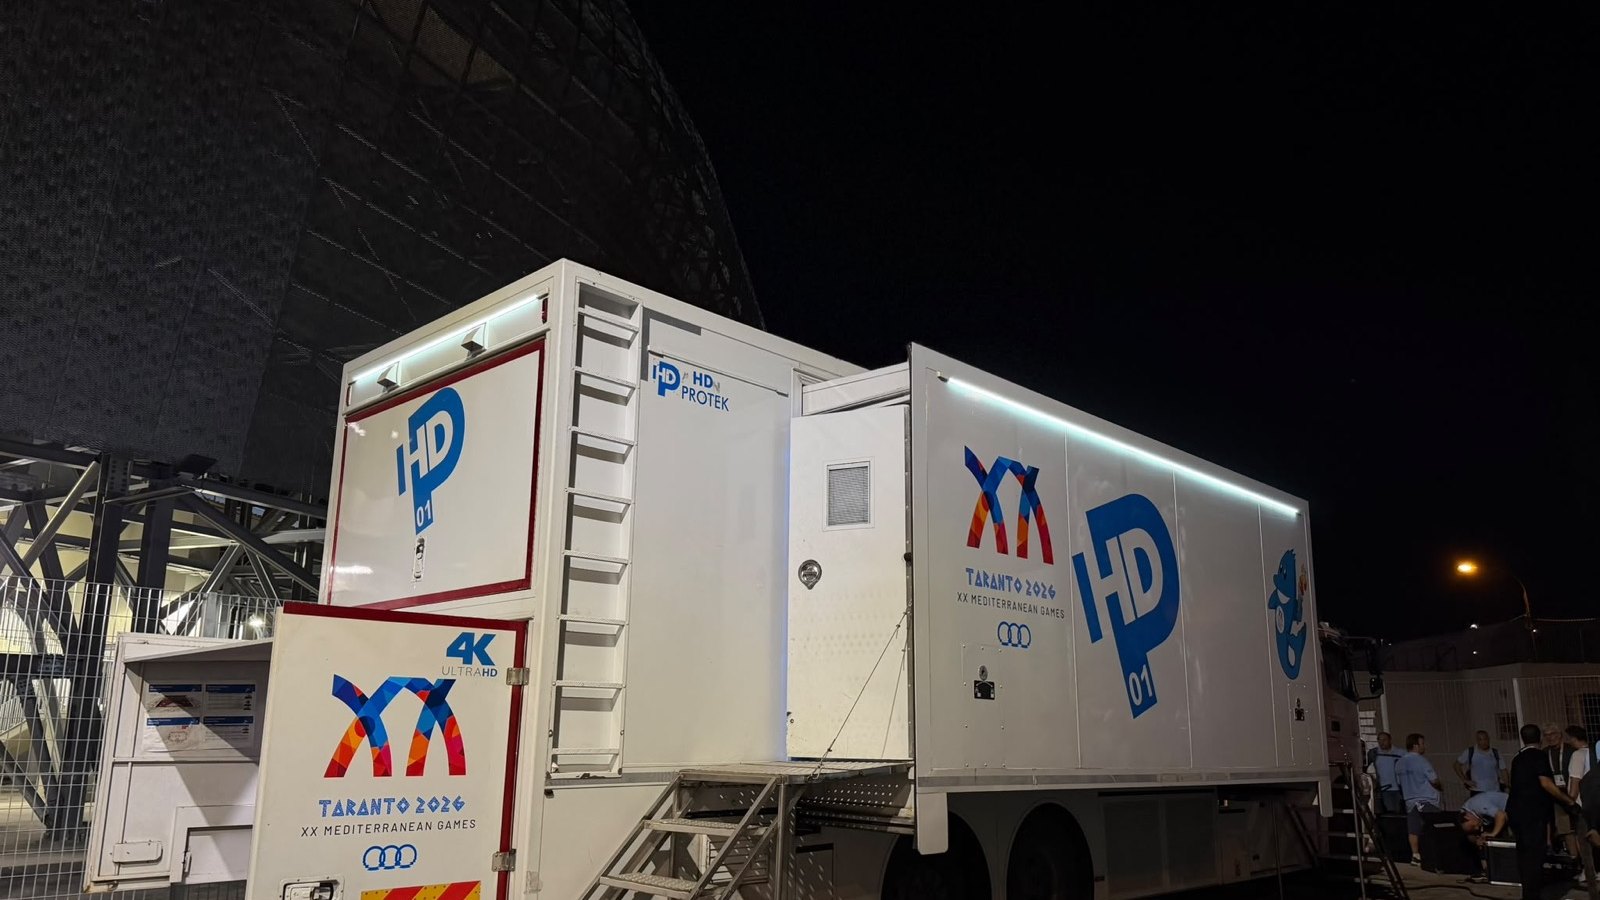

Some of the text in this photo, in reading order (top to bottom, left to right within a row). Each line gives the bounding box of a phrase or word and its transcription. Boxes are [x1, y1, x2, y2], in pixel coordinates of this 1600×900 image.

[693, 371, 713, 388] HD
[682, 386, 729, 412] PROTEK
[416, 500, 431, 527] 01
[965, 567, 1056, 600] TARANTO 2026
[957, 592, 1065, 619] XX MEDITERRANEAN GAMES
[446, 632, 496, 666] 4K
[1129, 664, 1152, 706] 01
[319, 795, 465, 817] TARANTO 2026
[301, 819, 476, 837] XX MEDITERRANEAN GAMES
